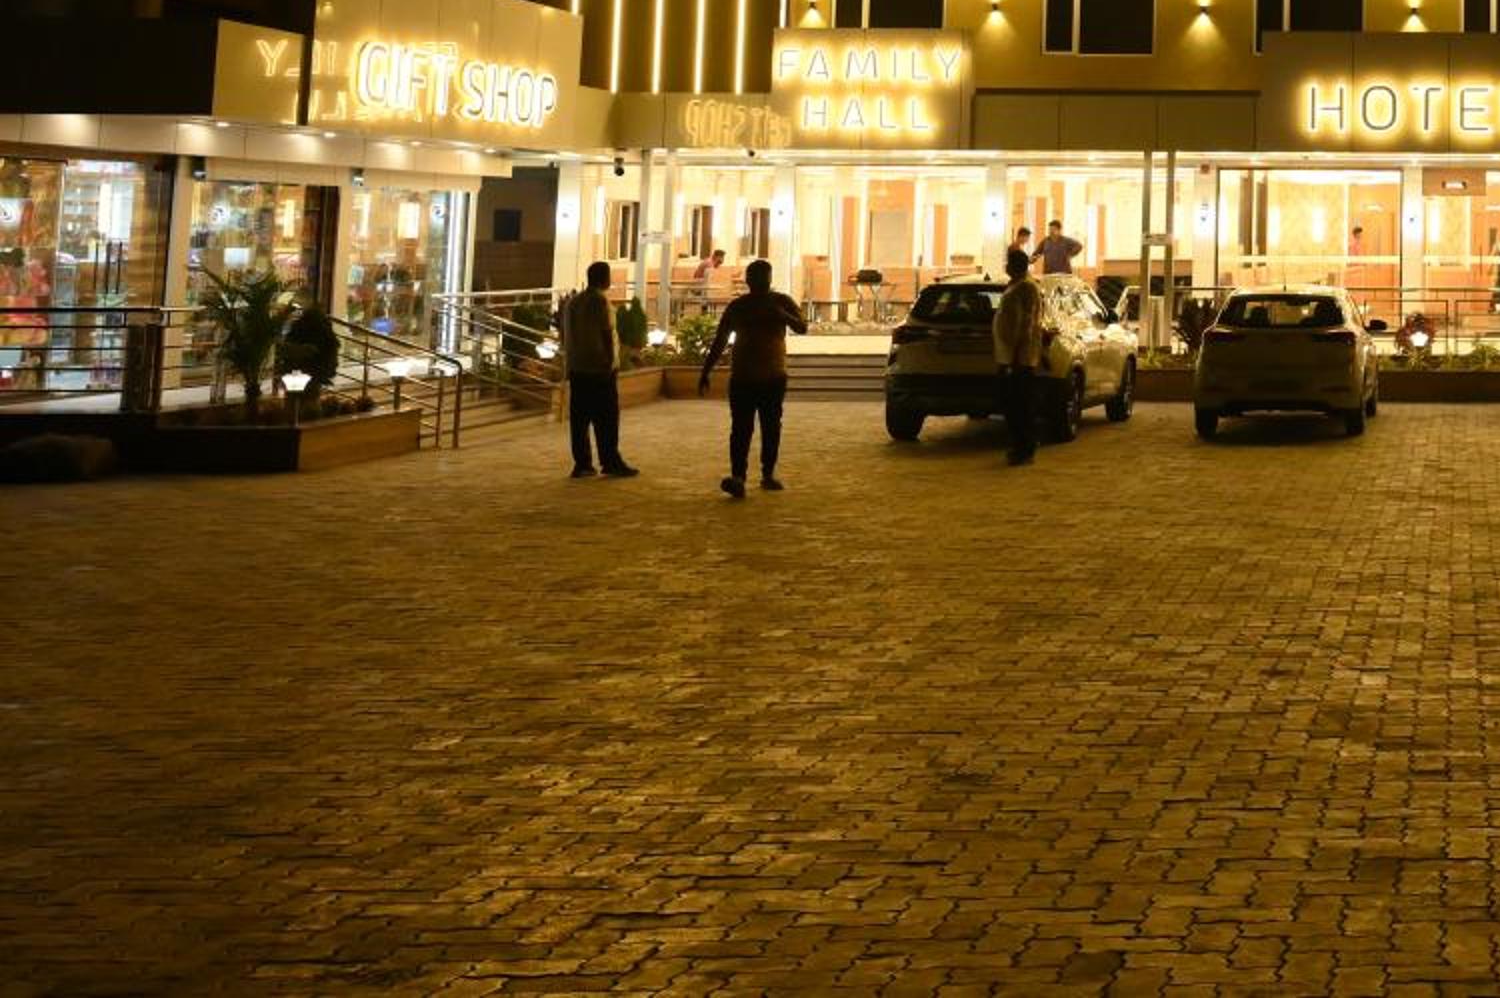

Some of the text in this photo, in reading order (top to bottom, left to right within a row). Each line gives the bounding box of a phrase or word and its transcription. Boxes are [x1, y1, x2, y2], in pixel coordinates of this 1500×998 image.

[775, 47, 963, 82] FAMILY
[356, 39, 455, 116] GIFT
[460, 58, 558, 129] SHOP
[801, 97, 932, 131] HALL
